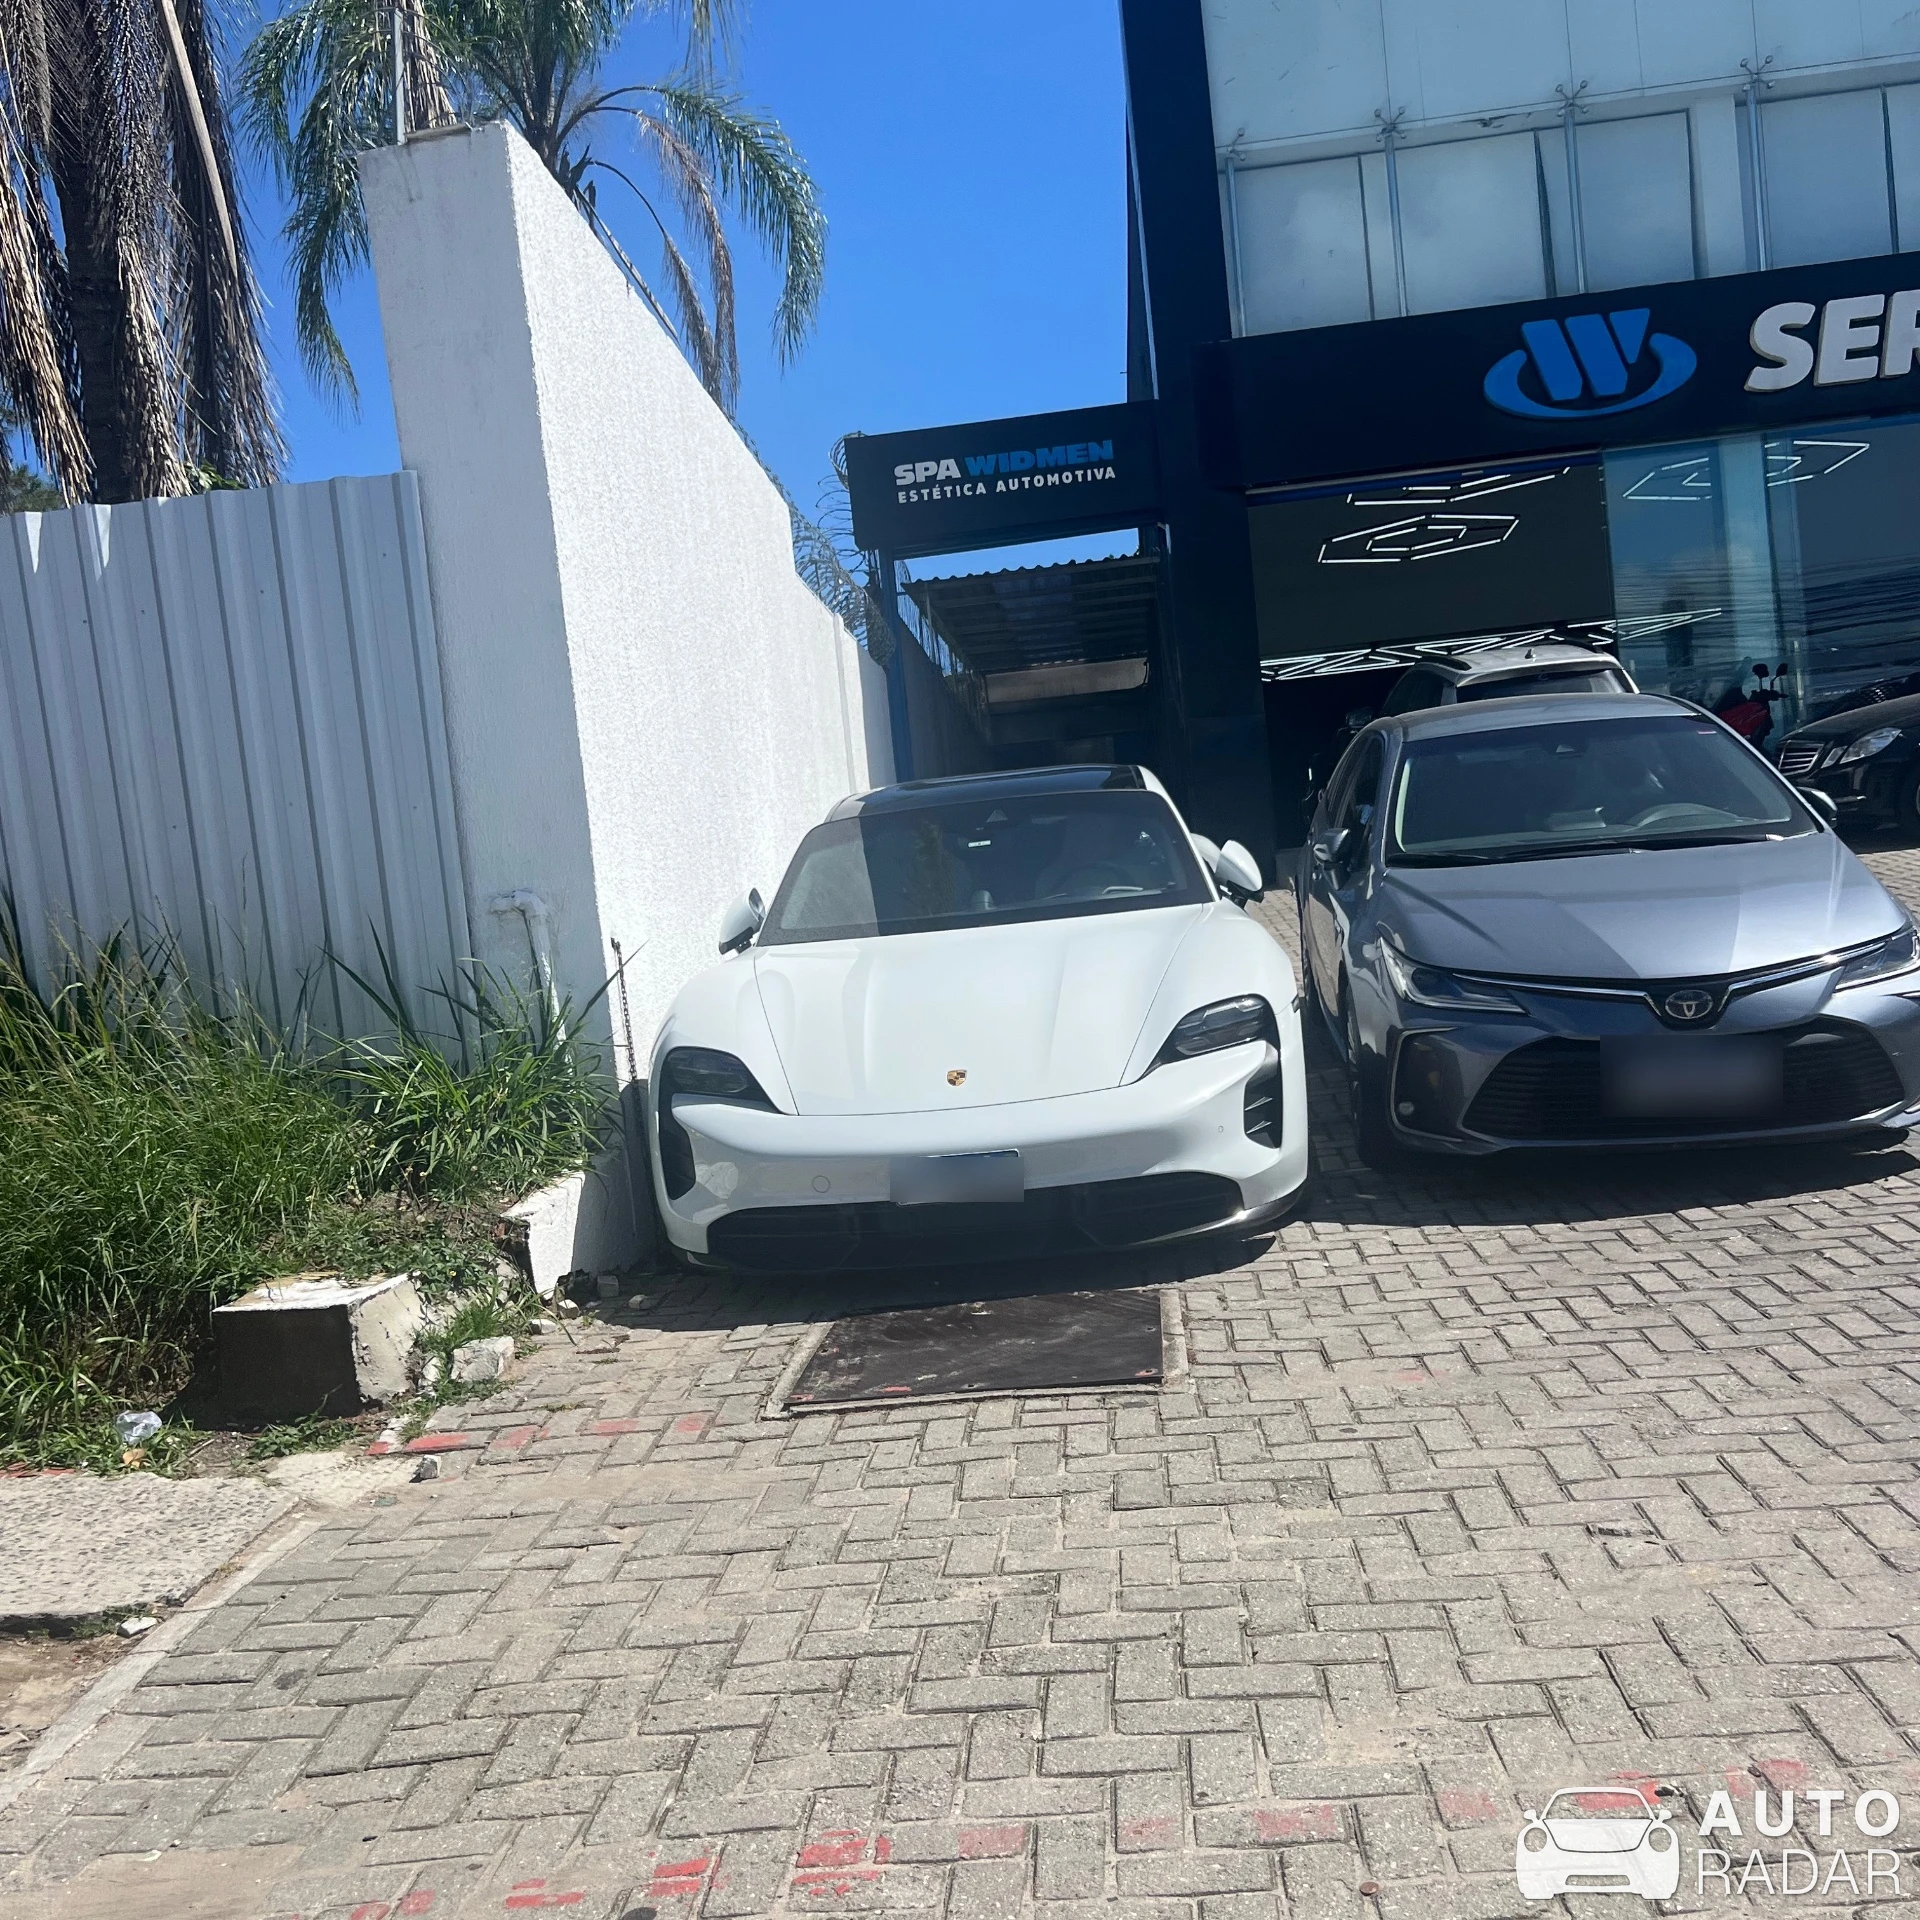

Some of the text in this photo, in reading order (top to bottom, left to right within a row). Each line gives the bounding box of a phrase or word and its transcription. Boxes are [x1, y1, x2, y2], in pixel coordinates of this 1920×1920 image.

[894, 440, 1114, 485] SPA WIDMEN
[897, 466, 1116, 503] ESTÉTICA AUTOMOTIVA
